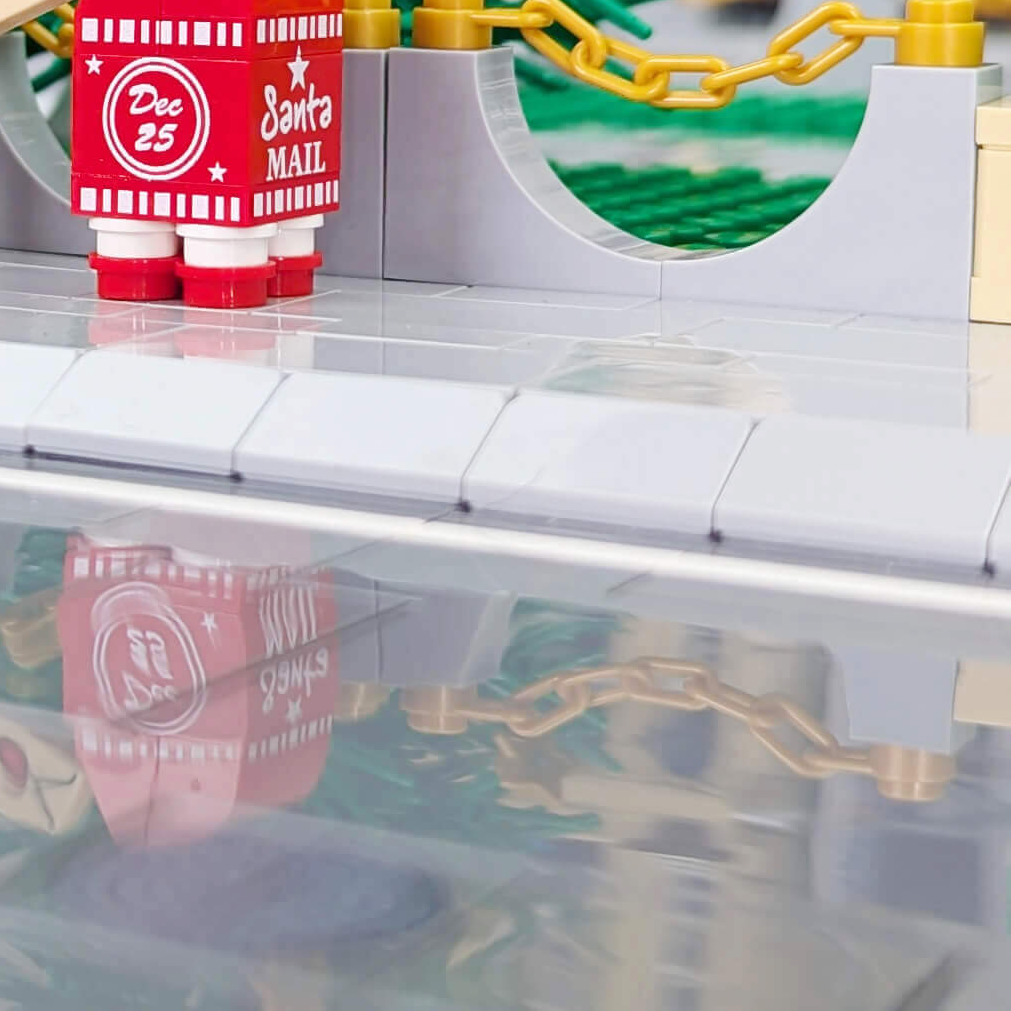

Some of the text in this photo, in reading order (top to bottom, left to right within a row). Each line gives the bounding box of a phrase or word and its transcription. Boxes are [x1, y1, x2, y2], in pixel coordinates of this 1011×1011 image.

[128, 83, 183, 116] Dec
[260, 83, 333, 141] Santa
[134, 122, 178, 152] 25
[265, 141, 326, 181] MAIL
